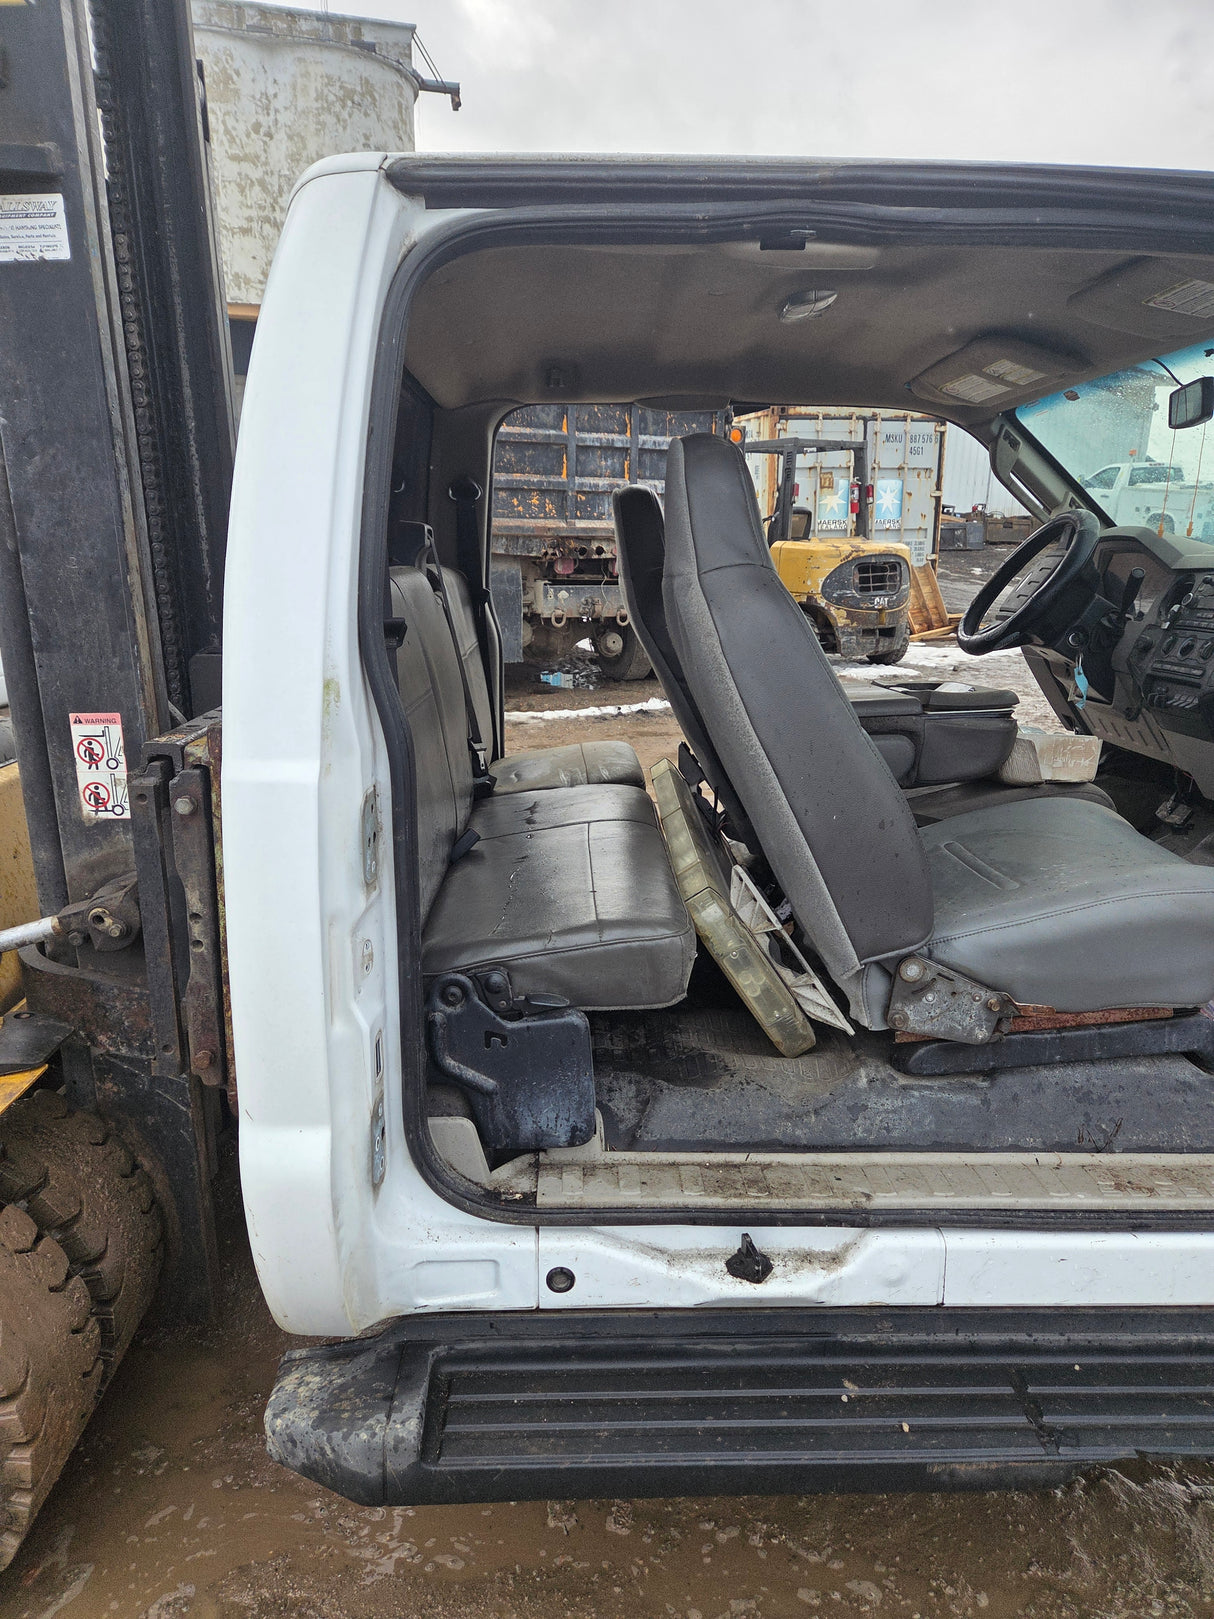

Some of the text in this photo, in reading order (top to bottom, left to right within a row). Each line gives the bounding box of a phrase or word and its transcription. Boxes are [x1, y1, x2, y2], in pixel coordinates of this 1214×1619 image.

[885, 433, 903, 444] MSKU
[909, 446, 924, 456] 45G1
[874, 597, 889, 608] CAT
